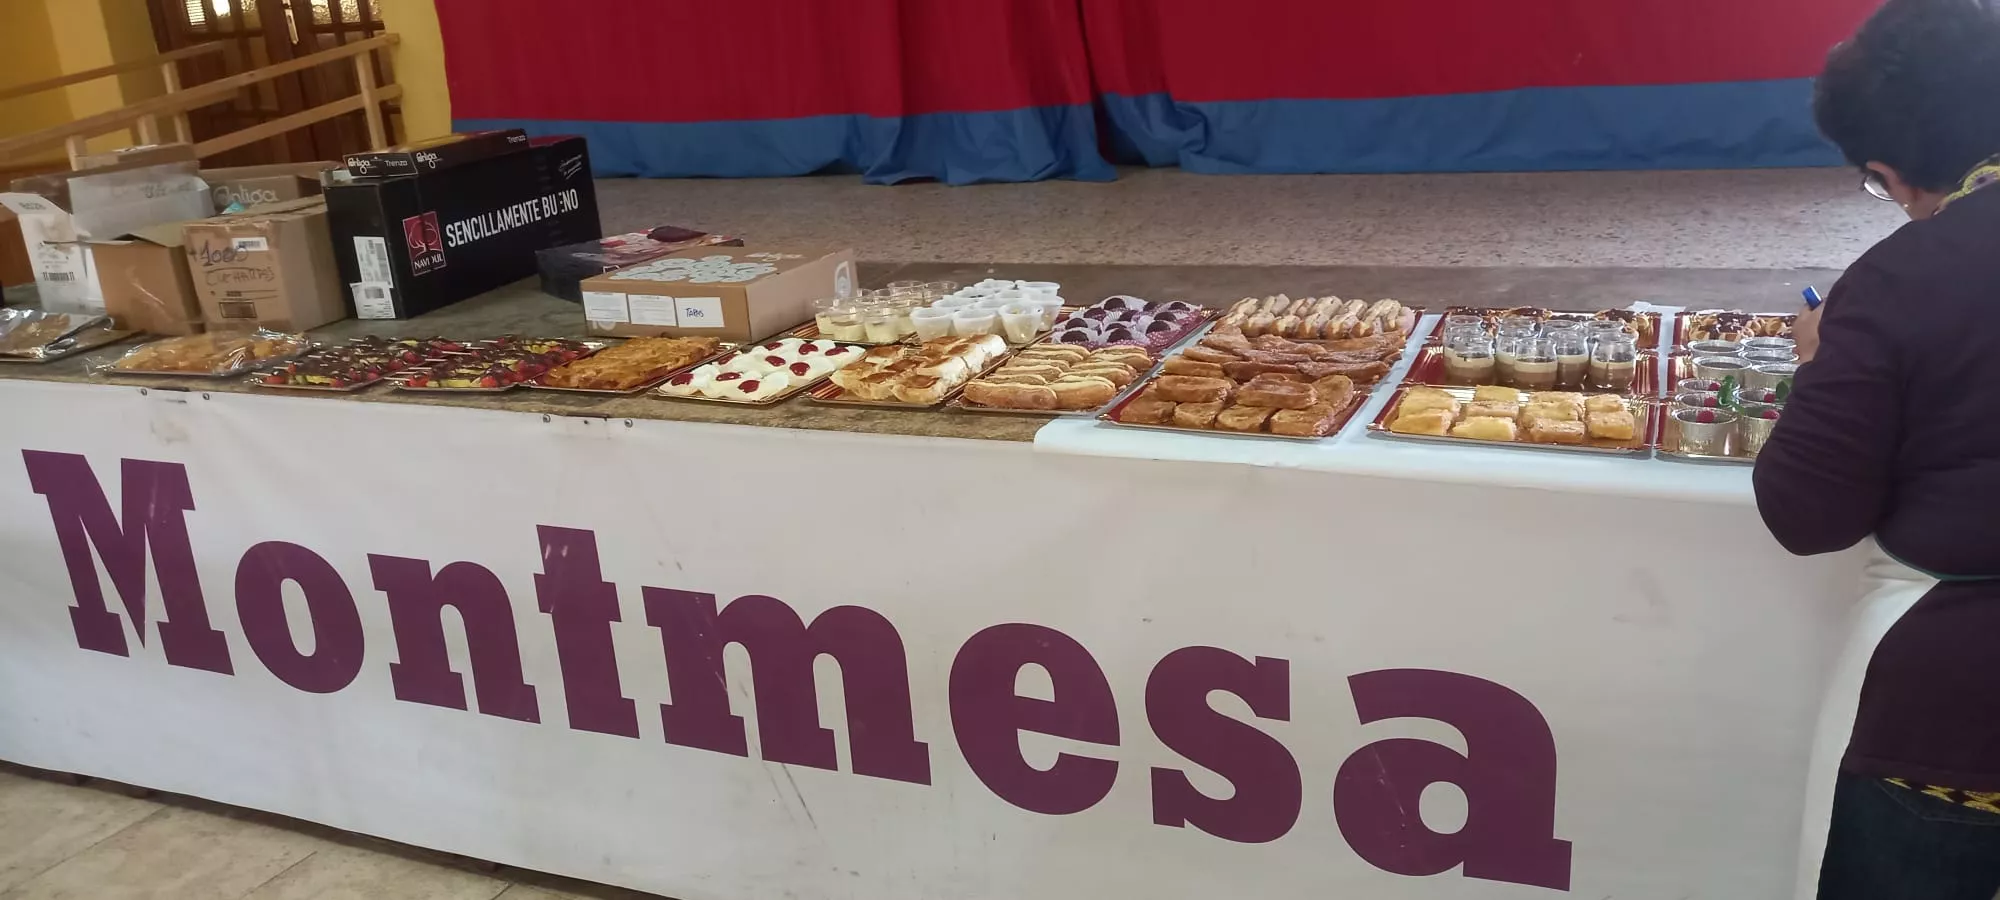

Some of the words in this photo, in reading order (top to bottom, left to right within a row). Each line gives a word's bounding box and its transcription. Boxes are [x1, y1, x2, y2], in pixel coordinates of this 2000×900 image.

[384, 159, 408, 168] Trenza
[446, 199, 541, 248] SENCILLAMENTE
[21, 449, 1572, 891] Montmesa
